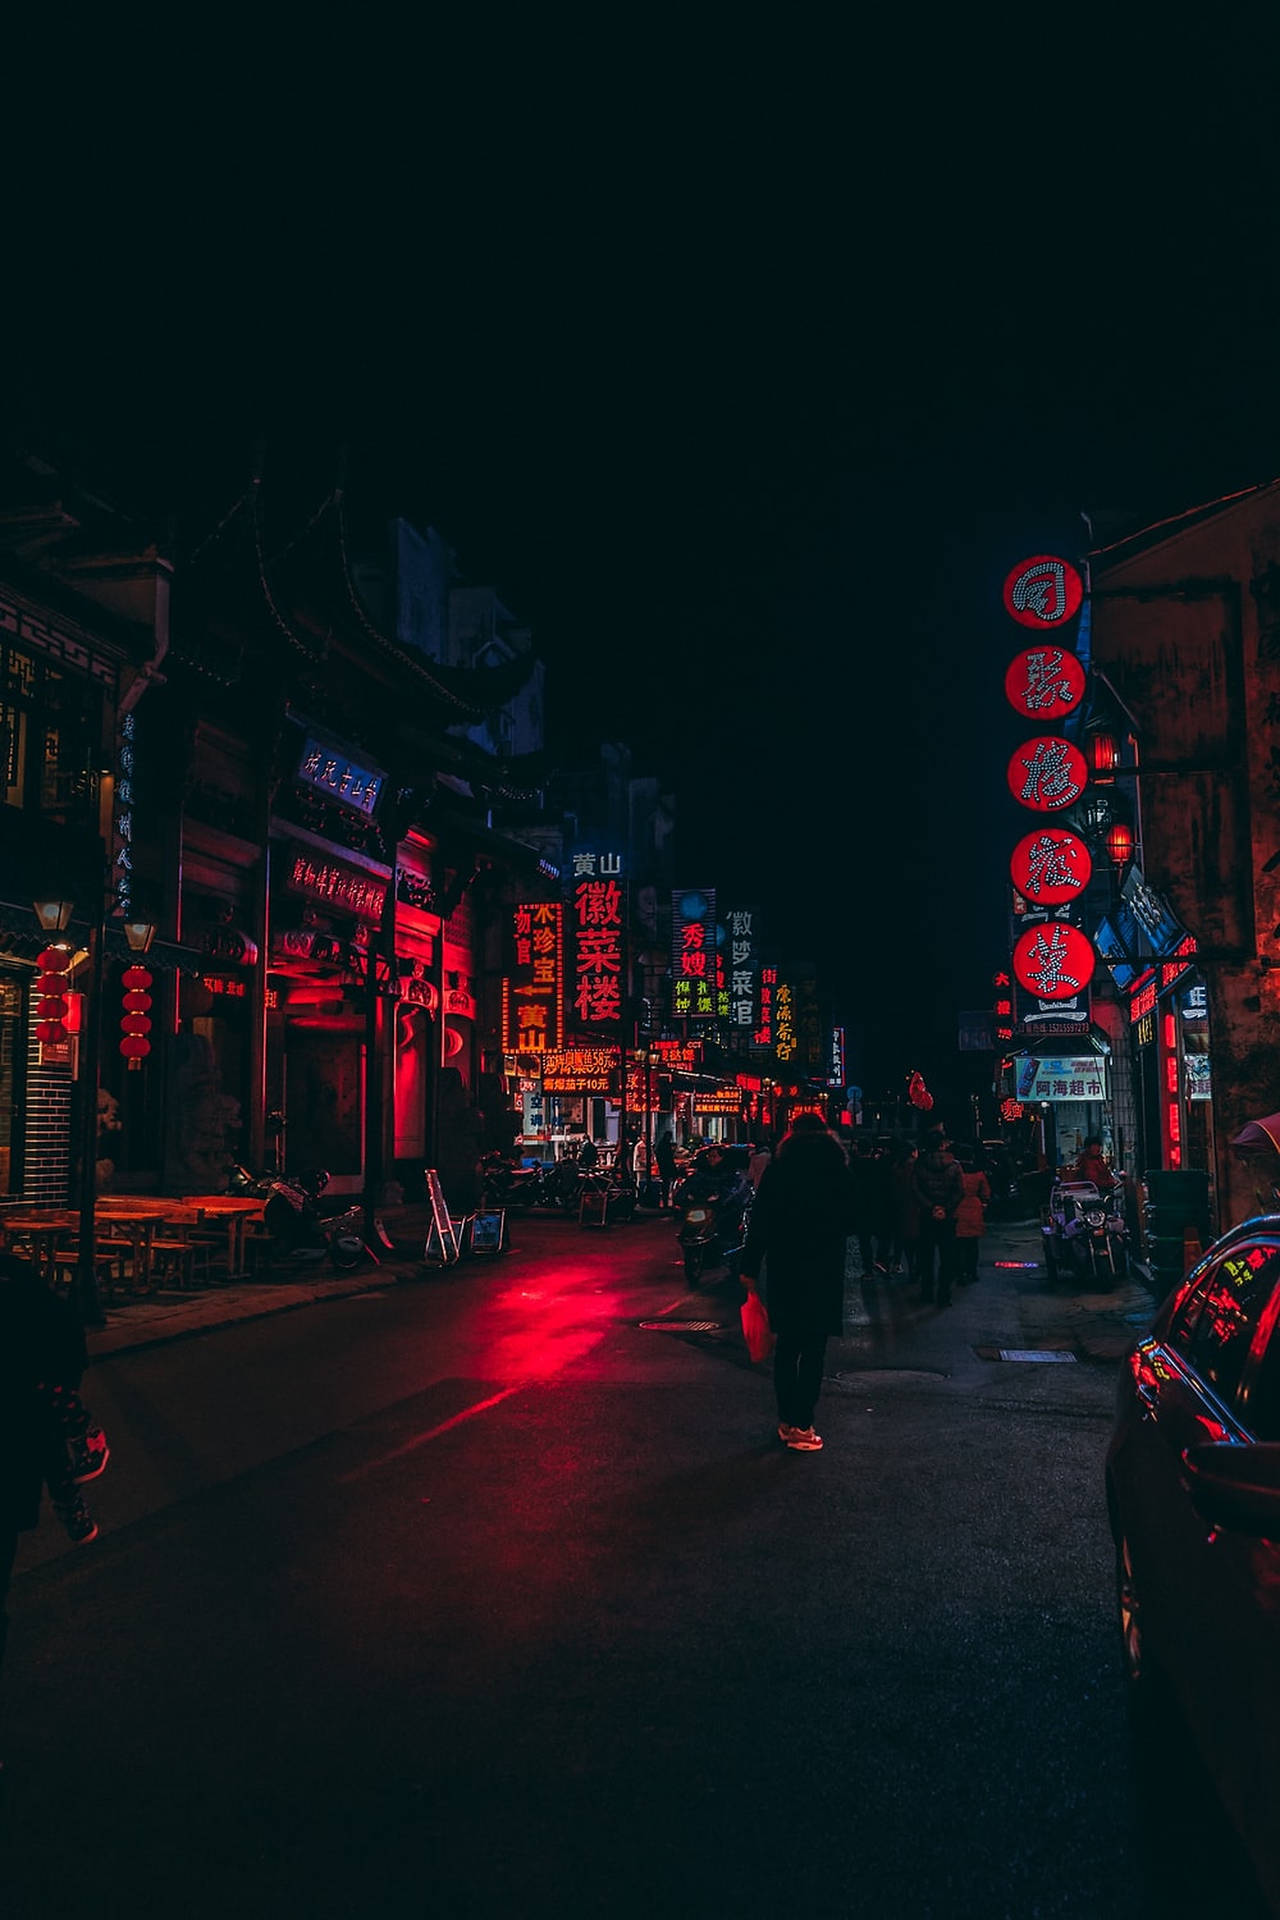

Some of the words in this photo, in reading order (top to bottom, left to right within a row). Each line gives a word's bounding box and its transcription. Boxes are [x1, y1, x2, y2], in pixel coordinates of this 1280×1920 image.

[572, 853, 622, 878] 黄山
[575, 881, 622, 1020] 徽菜楼
[680, 923, 706, 977] 秀嫂
[516, 1004, 548, 1051] 黄山
[1036, 1079, 1102, 1097] 阿海超市
